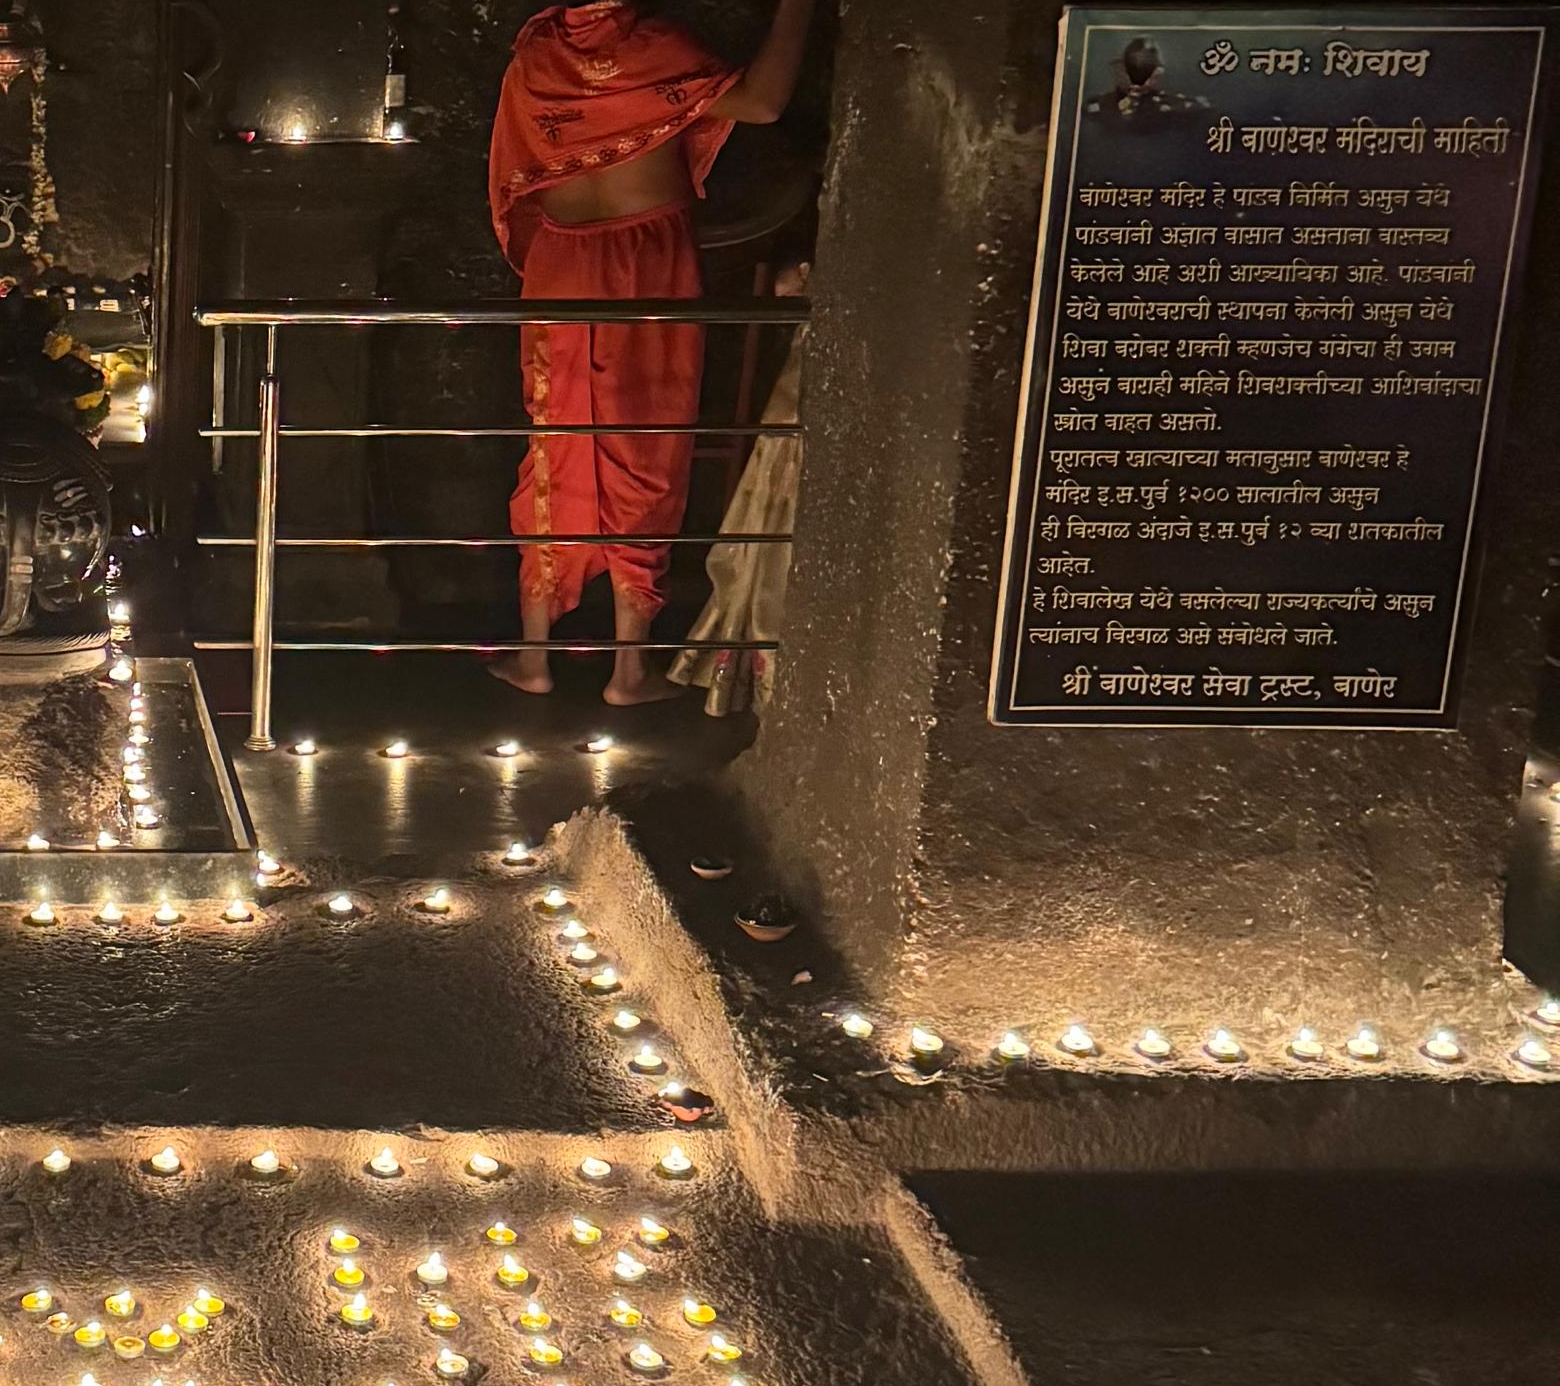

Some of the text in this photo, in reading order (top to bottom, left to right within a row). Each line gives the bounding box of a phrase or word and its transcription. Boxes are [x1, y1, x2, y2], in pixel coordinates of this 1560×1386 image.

[1200, 41, 1431, 78] ॐ नमः शिवाय
[1206, 115, 1511, 158] श्री बाणेश्वर मंदिराची माहिती
[1159, 180, 1207, 209] मंदिर
[1211, 181, 1227, 210] हे
[1288, 180, 1351, 207] निर्मित
[1357, 189, 1411, 215] असुन
[1415, 182, 1451, 208] येथे
[1074, 218, 1154, 245] पांडवांनी
[1223, 226, 1285, 245] वासात
[1290, 226, 1373, 246] असताना
[1377, 227, 1451, 246] वास्तव्य
[1069, 257, 1126, 283] केलेले
[1131, 257, 1171, 286] आहे
[1176, 257, 1223, 284] अशी
[1065, 294, 1455, 328] येथे बाणेश्वराची स्थापना केलेली असुन येथे
[1061, 332, 1109, 359] शिवा
[1113, 332, 1171, 359] बरोबर
[1175, 332, 1232, 359] शक्ती
[1236, 332, 1314, 361] म्हणजेच
[1383, 333, 1404, 361] ही
[1408, 340, 1457, 359] उगम
[1178, 369, 1232, 398] महिने
[1236, 369, 1365, 396] शिवशक्तीच्या
[1103, 413, 1154, 435] वाहत
[1124, 449, 1221, 468] खात्याच्या
[1224, 449, 1313, 475] मतानुसार
[1317, 443, 1392, 469] बाणेश्वर
[1396, 443, 1411, 471] हे
[1044, 479, 1092, 506] मंदिर
[1178, 485, 1230, 504] १२००
[1235, 479, 1323, 505] सालातील
[1328, 486, 1381, 511] असुन
[1040, 514, 1062, 542] ही
[1065, 514, 1133, 540] विरगळ
[1136, 514, 1194, 541] अंदाजे
[1278, 522, 1303, 540] १२
[1308, 521, 1343, 541] व्या
[1347, 516, 1445, 541] शतकातील
[1032, 585, 1047, 613] हे
[1139, 586, 1175, 610] येथे
[1178, 586, 1262, 611] वसलेल्या
[1383, 593, 1437, 619] असुन
[1028, 621, 1101, 645] त्यांनाच
[1104, 621, 1172, 645] विरगळ
[1175, 621, 1213, 646] असे
[1216, 621, 1289, 646] संबोधले
[1201, 665, 1253, 697] सेवा
[1258, 675, 1322, 702] ट्रस्ट,
[1332, 667, 1398, 699] बाणेर
